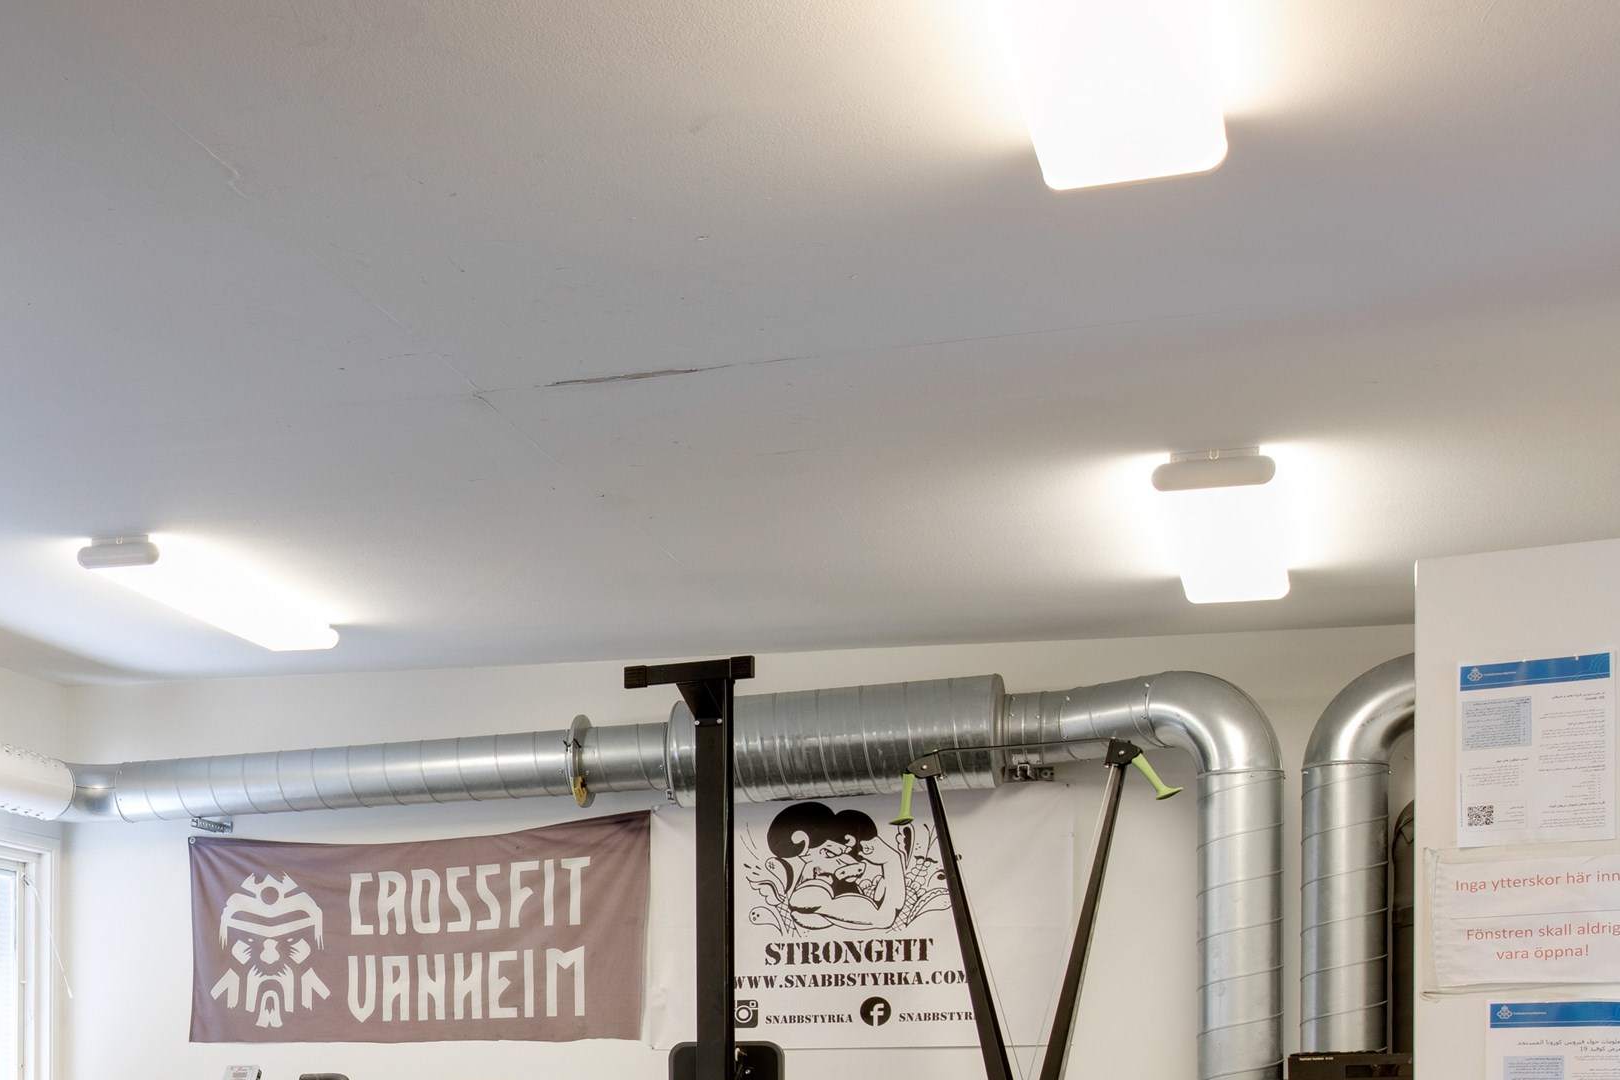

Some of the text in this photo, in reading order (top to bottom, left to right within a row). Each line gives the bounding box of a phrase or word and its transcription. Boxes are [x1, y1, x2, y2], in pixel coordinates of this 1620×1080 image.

[1455, 880, 1487, 893] Inga
[1491, 874, 1561, 892] ytterskor
[1566, 872, 1592, 884] här
[350, 856, 591, 936] CROSSFIT
[1466, 922, 1620, 941] Fönstren skall aldrig
[764, 937, 934, 966] STRONGFIT
[1496, 944, 1589, 960] vara öppna!
[347, 946, 586, 1023] VANHEIM
[735, 969, 970, 990] WWW.SNABBSTYRKA.COM
[765, 1013, 853, 1025] SNABBSTYRKA
[898, 1011, 976, 1023] SNABBSTYR
